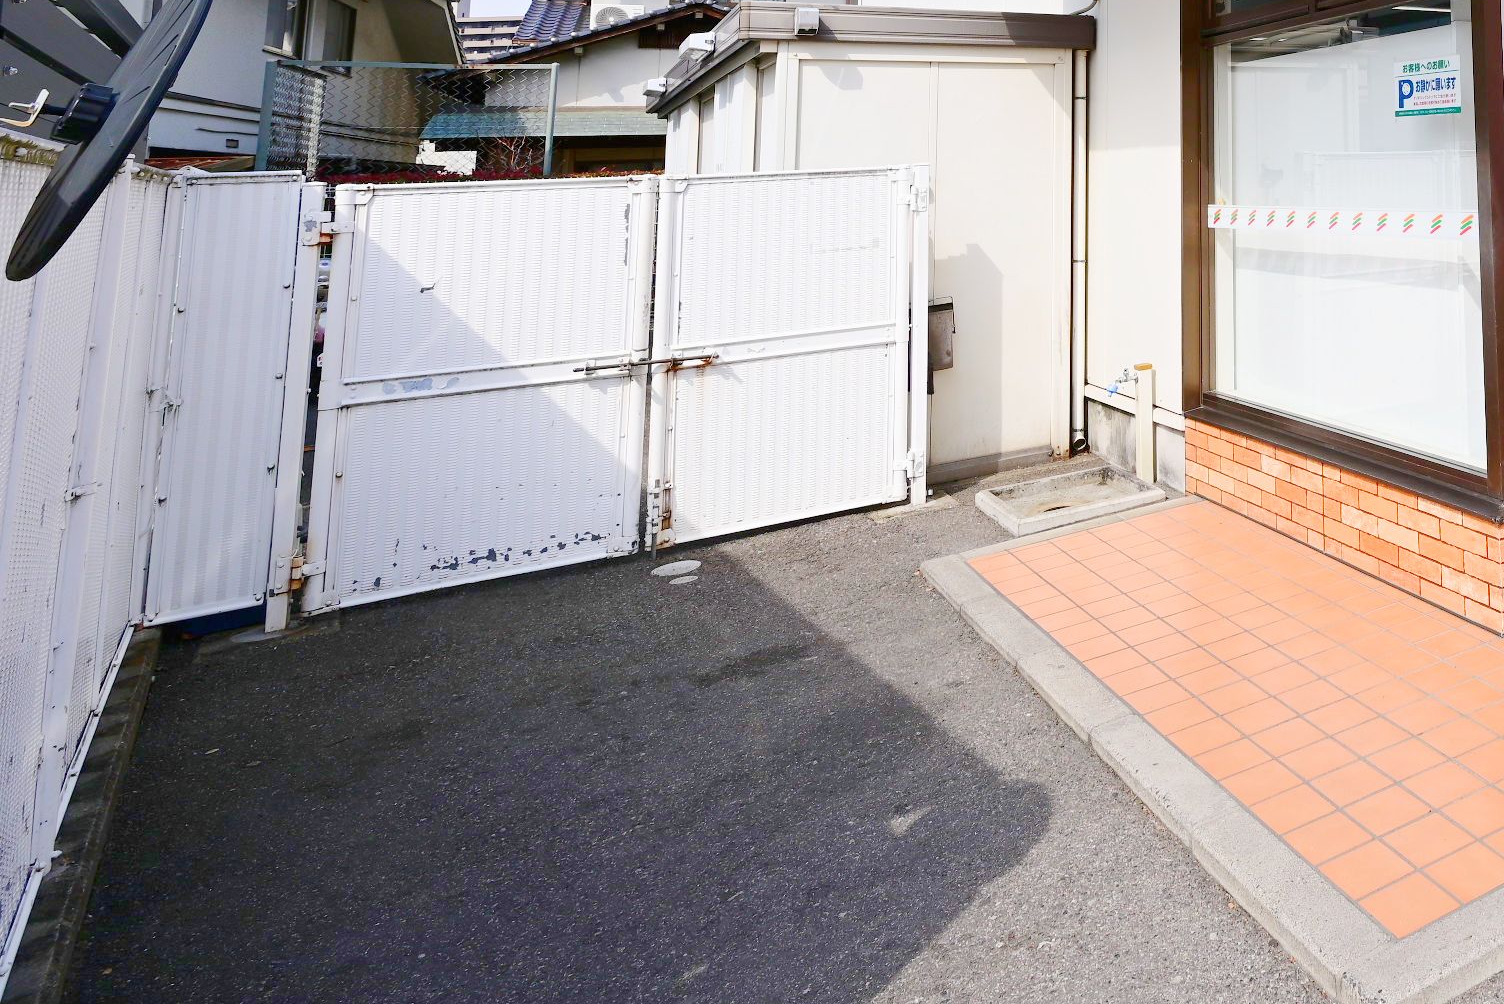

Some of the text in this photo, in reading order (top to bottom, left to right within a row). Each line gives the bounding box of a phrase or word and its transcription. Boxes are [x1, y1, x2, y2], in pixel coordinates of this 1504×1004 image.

[1402, 59, 1451, 74] お客様へのお願い
[1415, 76, 1457, 93] お静かに願います
[1398, 79, 1414, 109] P
